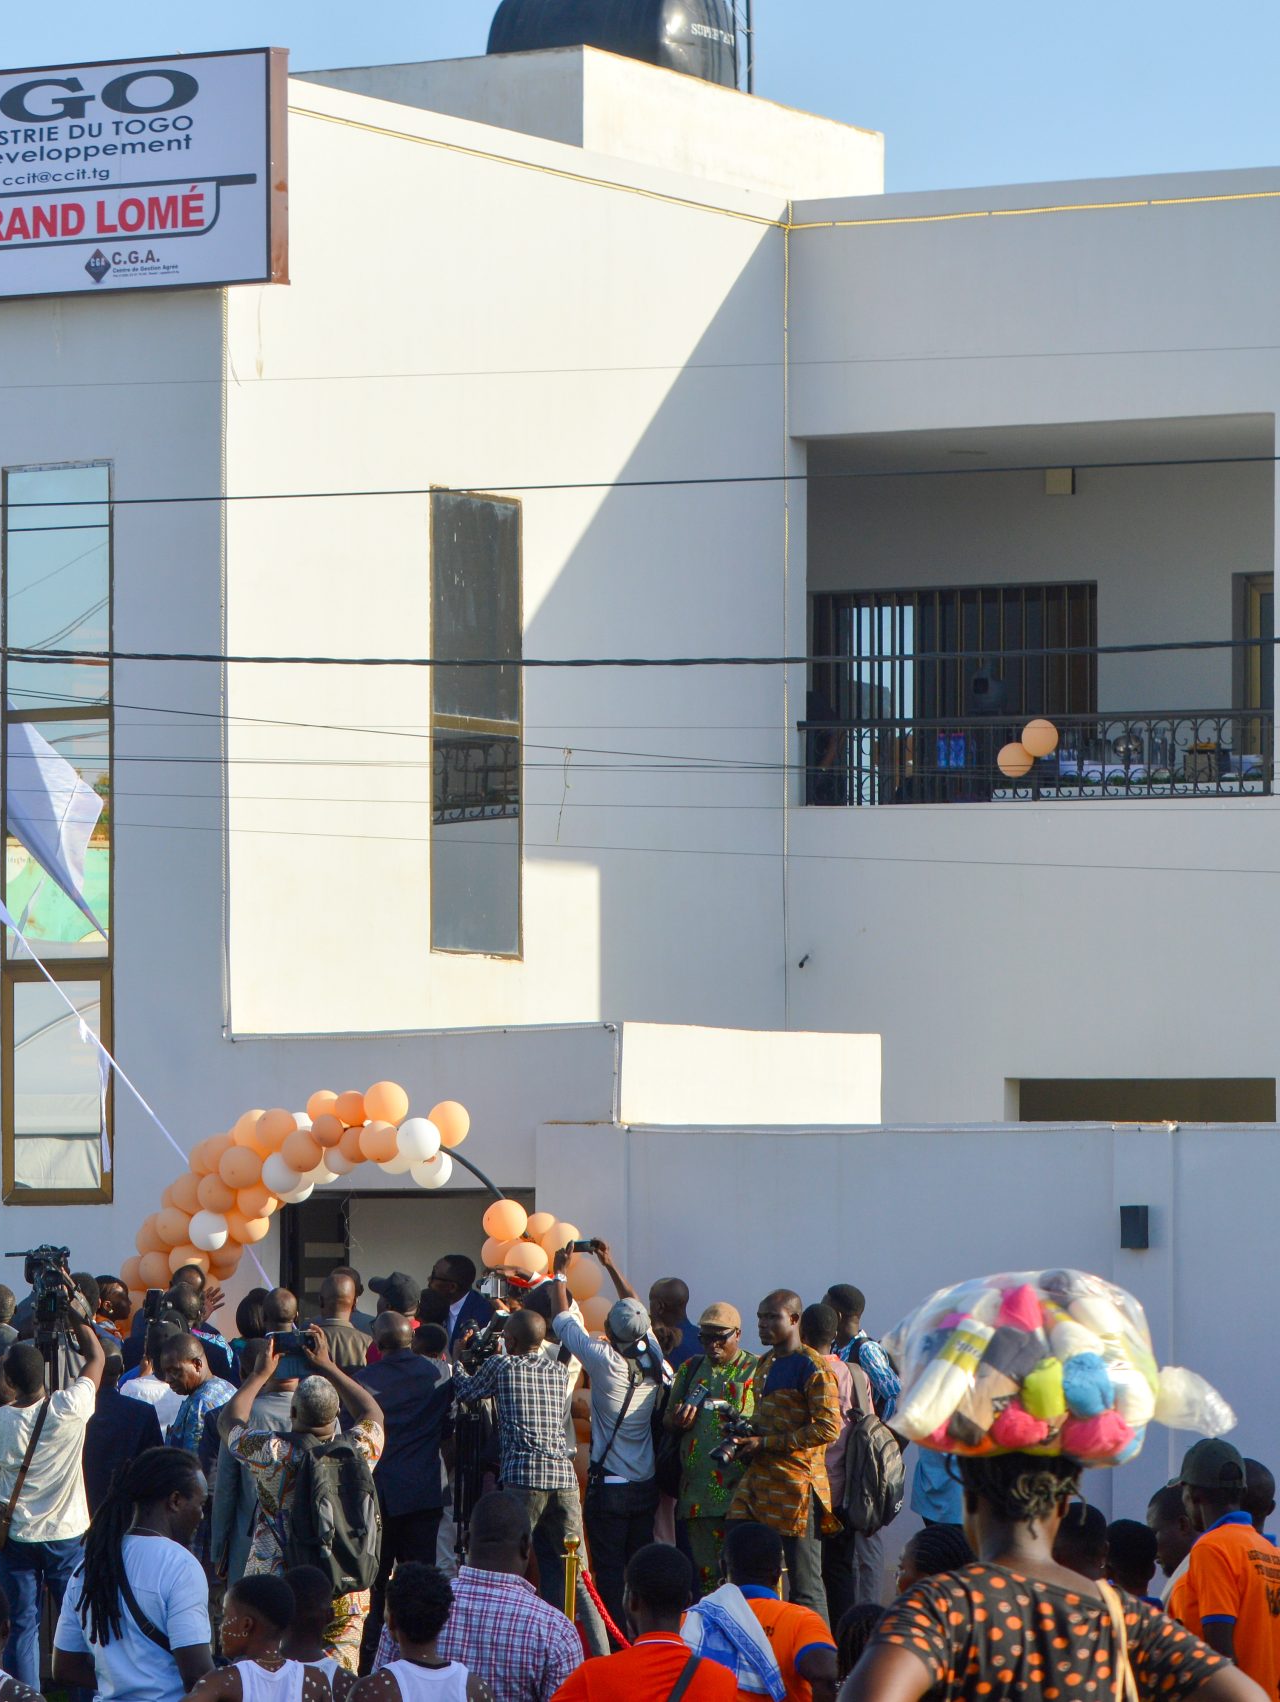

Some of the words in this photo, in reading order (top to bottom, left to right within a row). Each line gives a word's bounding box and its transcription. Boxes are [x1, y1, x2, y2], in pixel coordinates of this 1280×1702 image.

[69, 122, 103, 140] DU
[112, 115, 194, 136] TOGO
[2, 166, 111, 186] ccit@ccit.tg
[96, 185, 205, 234] LOMÉ
[112, 250, 160, 265] C.G.A.
